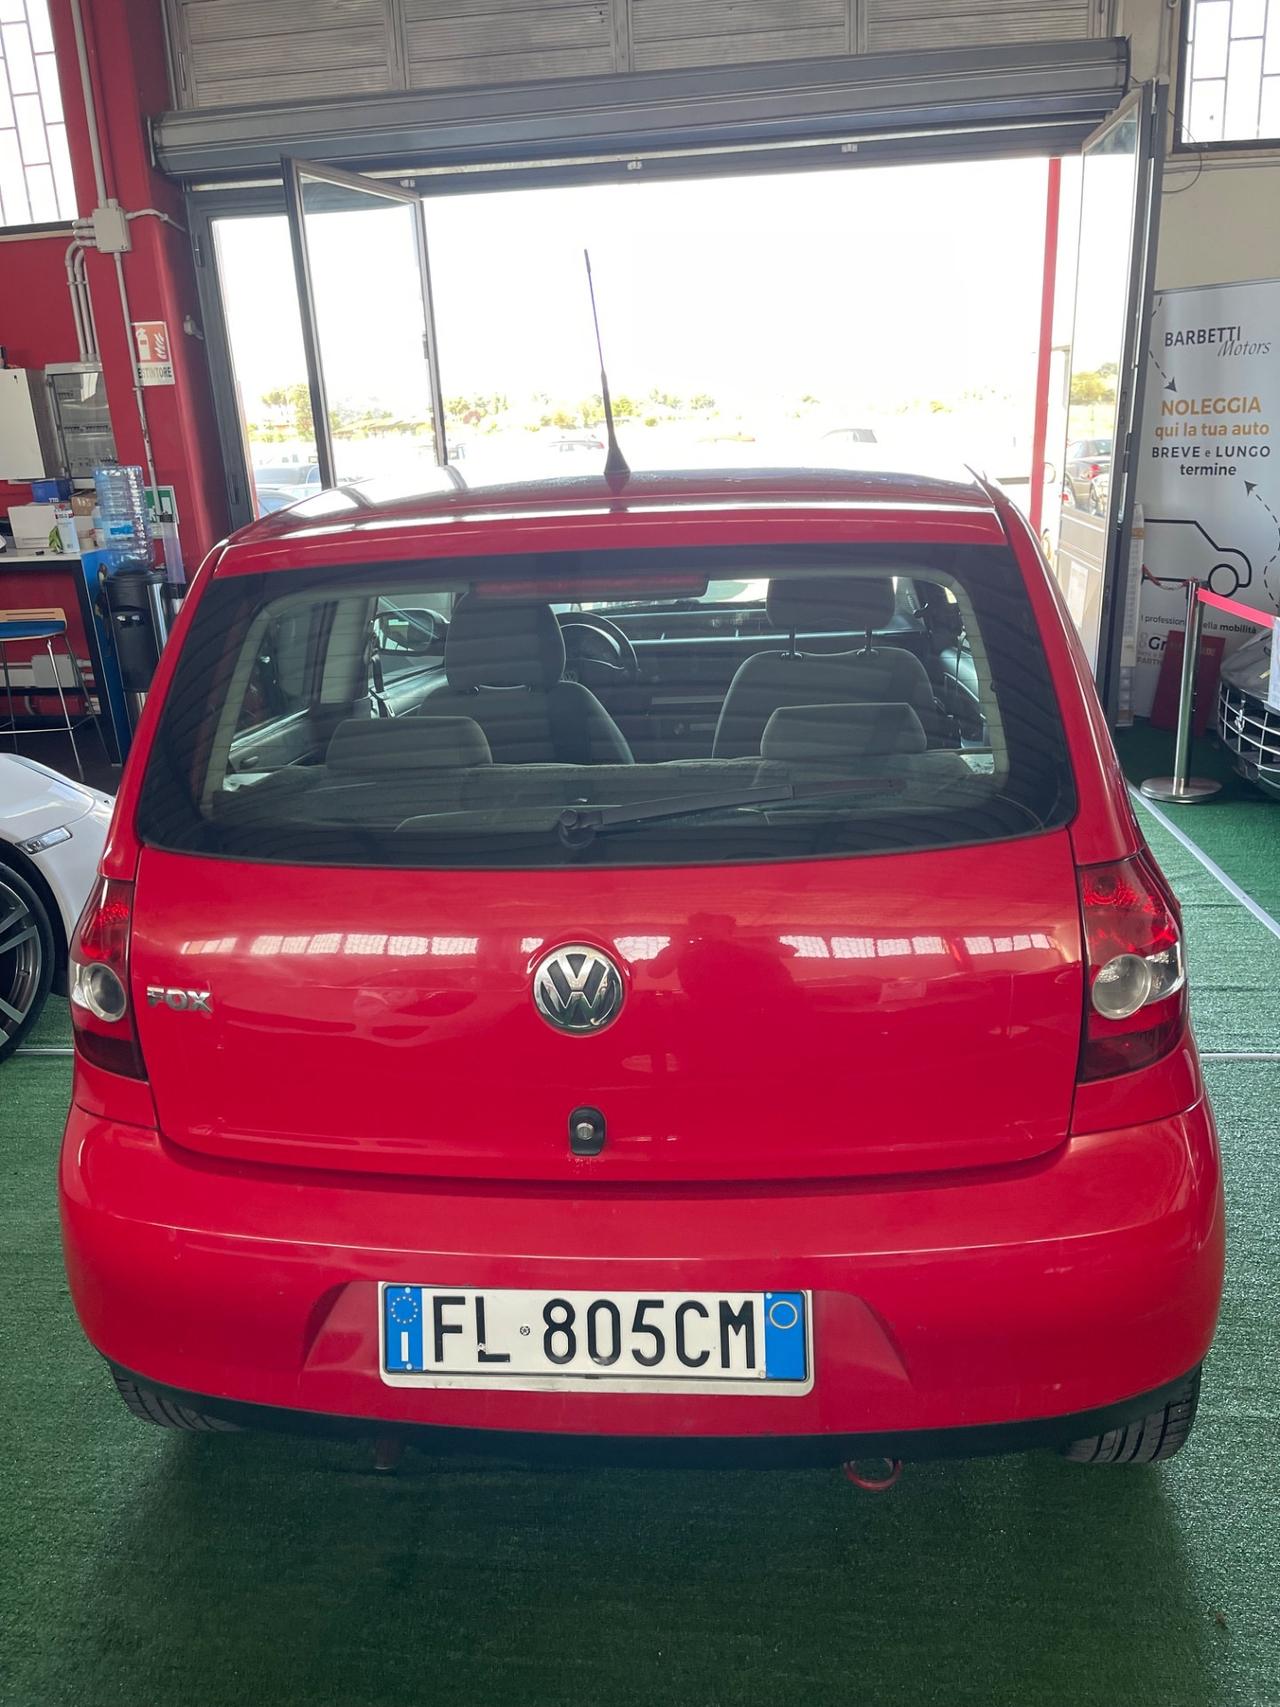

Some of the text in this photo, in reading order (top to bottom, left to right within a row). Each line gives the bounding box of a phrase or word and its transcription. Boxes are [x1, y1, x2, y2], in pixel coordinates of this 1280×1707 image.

[1164, 326, 1241, 347] BARBETTI
[1217, 339, 1272, 357] Motors
[137, 366, 172, 379] ESTINTORE
[1161, 396, 1262, 416] NOLEGGIA
[1154, 422, 1270, 440] qui la tua auto
[1151, 445, 1271, 458] BREVE e LUNGO
[1180, 462, 1237, 476] termine
[146, 986, 213, 1013] FOX
[433, 1295, 757, 1369] FL 805CM
